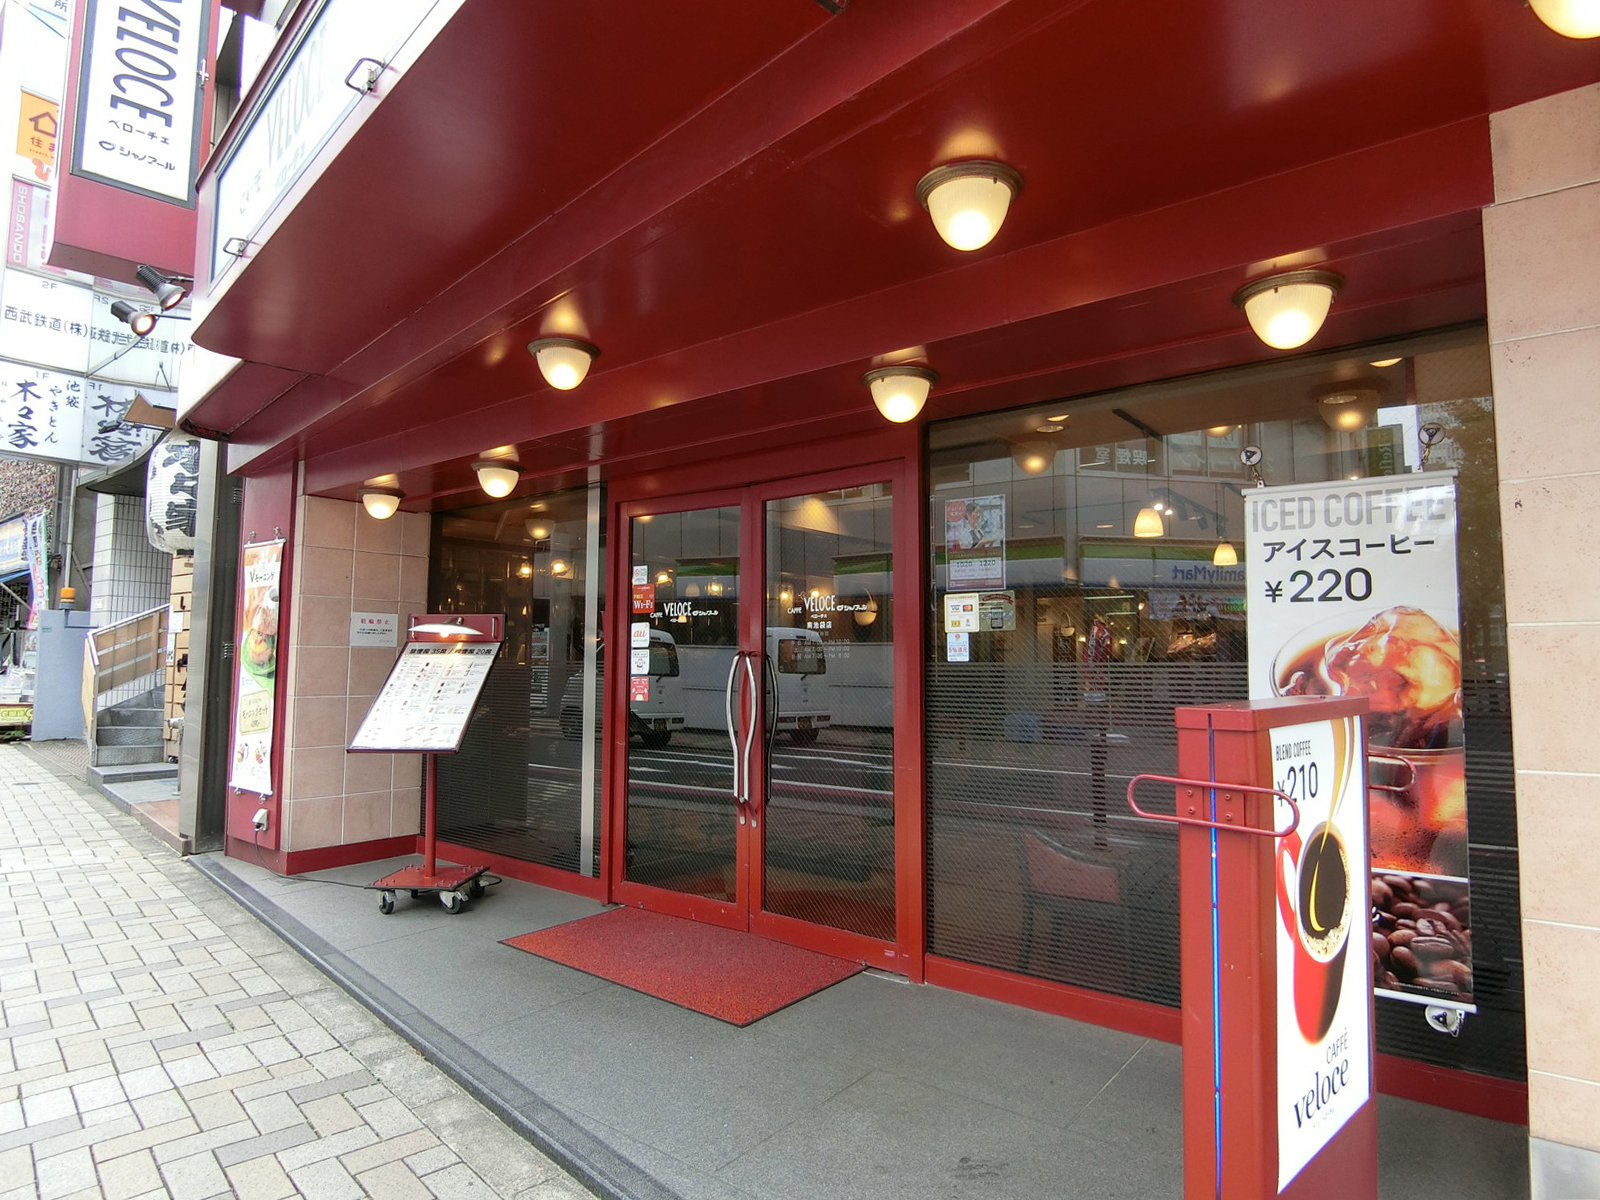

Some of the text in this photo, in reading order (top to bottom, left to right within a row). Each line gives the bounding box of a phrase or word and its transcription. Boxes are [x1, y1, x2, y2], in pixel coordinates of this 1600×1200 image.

[108, 119, 170, 145] ベローチェ
[12, 185, 28, 264] SHOBANDO
[41, 280, 58, 290] 2F
[4, 304, 88, 338] 西武鉄道(株)
[35, 370, 50, 379] 1F
[65, 380, 81, 409] 池袋
[8, 379, 43, 449] 木々家
[44, 385, 62, 443] やきとん
[1252, 484, 1446, 532] ICED COFFEE
[1263, 534, 1435, 563] アイスコーヒー
[1265, 567, 1372, 603] ¥220
[633, 599, 653, 609] Wi-Fi
[663, 601, 692, 617] VELOCE
[803, 595, 836, 612] VELOCE
[633, 629, 648, 638] au
[1275, 740, 1311, 761] BLEND COFFEE
[1293, 1058, 1350, 1129] veloce
